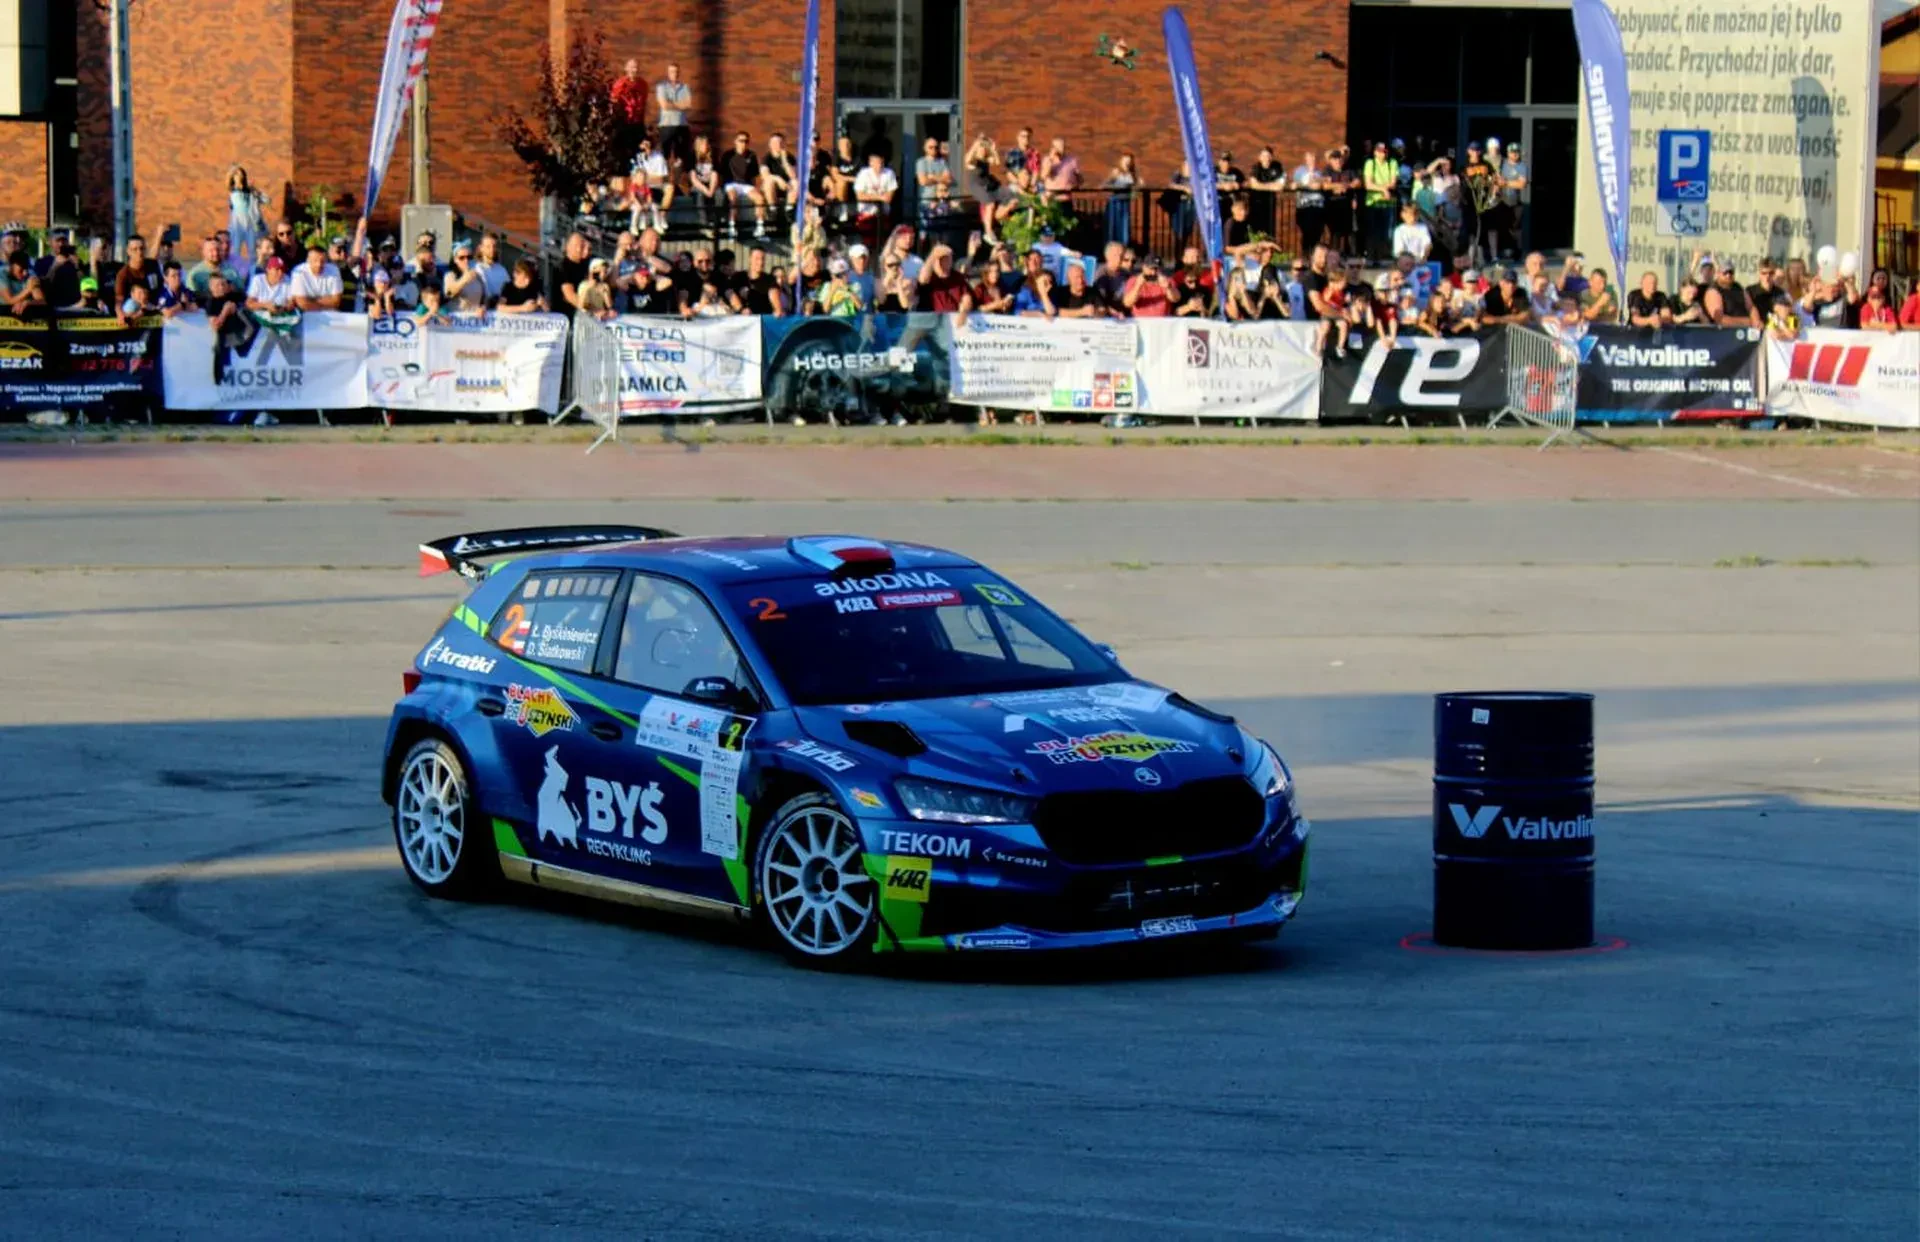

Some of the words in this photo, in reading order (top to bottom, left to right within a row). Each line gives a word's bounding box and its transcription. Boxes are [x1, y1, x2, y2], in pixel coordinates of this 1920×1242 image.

[1686, 4, 1710, 32] nie
[1713, 4, 1768, 32] można
[1770, 2, 1793, 38] jej
[1795, 4, 1841, 39] tylko
[1679, 44, 1769, 79] Przychodzi
[1771, 44, 1798, 79] jak
[1801, 45, 1835, 81] dar,
[1668, 82, 1691, 119] się
[1694, 92, 1758, 119] poprzez
[1762, 85, 1851, 123] zmaganie.
[1744, 133, 1764, 153] za
[1670, 135, 1700, 180] P
[1753, 210, 1770, 240] tę
[793, 350, 887, 371] HÖGERT
[1215, 351, 1273, 370] JACKA
[222, 368, 304, 387] MOSUR
[1633, 379, 1686, 393] ORIGINAL
[1688, 379, 1730, 393] MOTOR
[1732, 379, 1753, 393] OIL
[813, 572, 952, 597] autoDNA
[748, 597, 788, 621] 2
[498, 603, 526, 649] 2
[436, 646, 498, 674] kratki
[725, 722, 743, 752] 2
[586, 837, 652, 866] RECYKLING
[879, 830, 971, 859] TEKOM
[996, 851, 1048, 868] kratki
